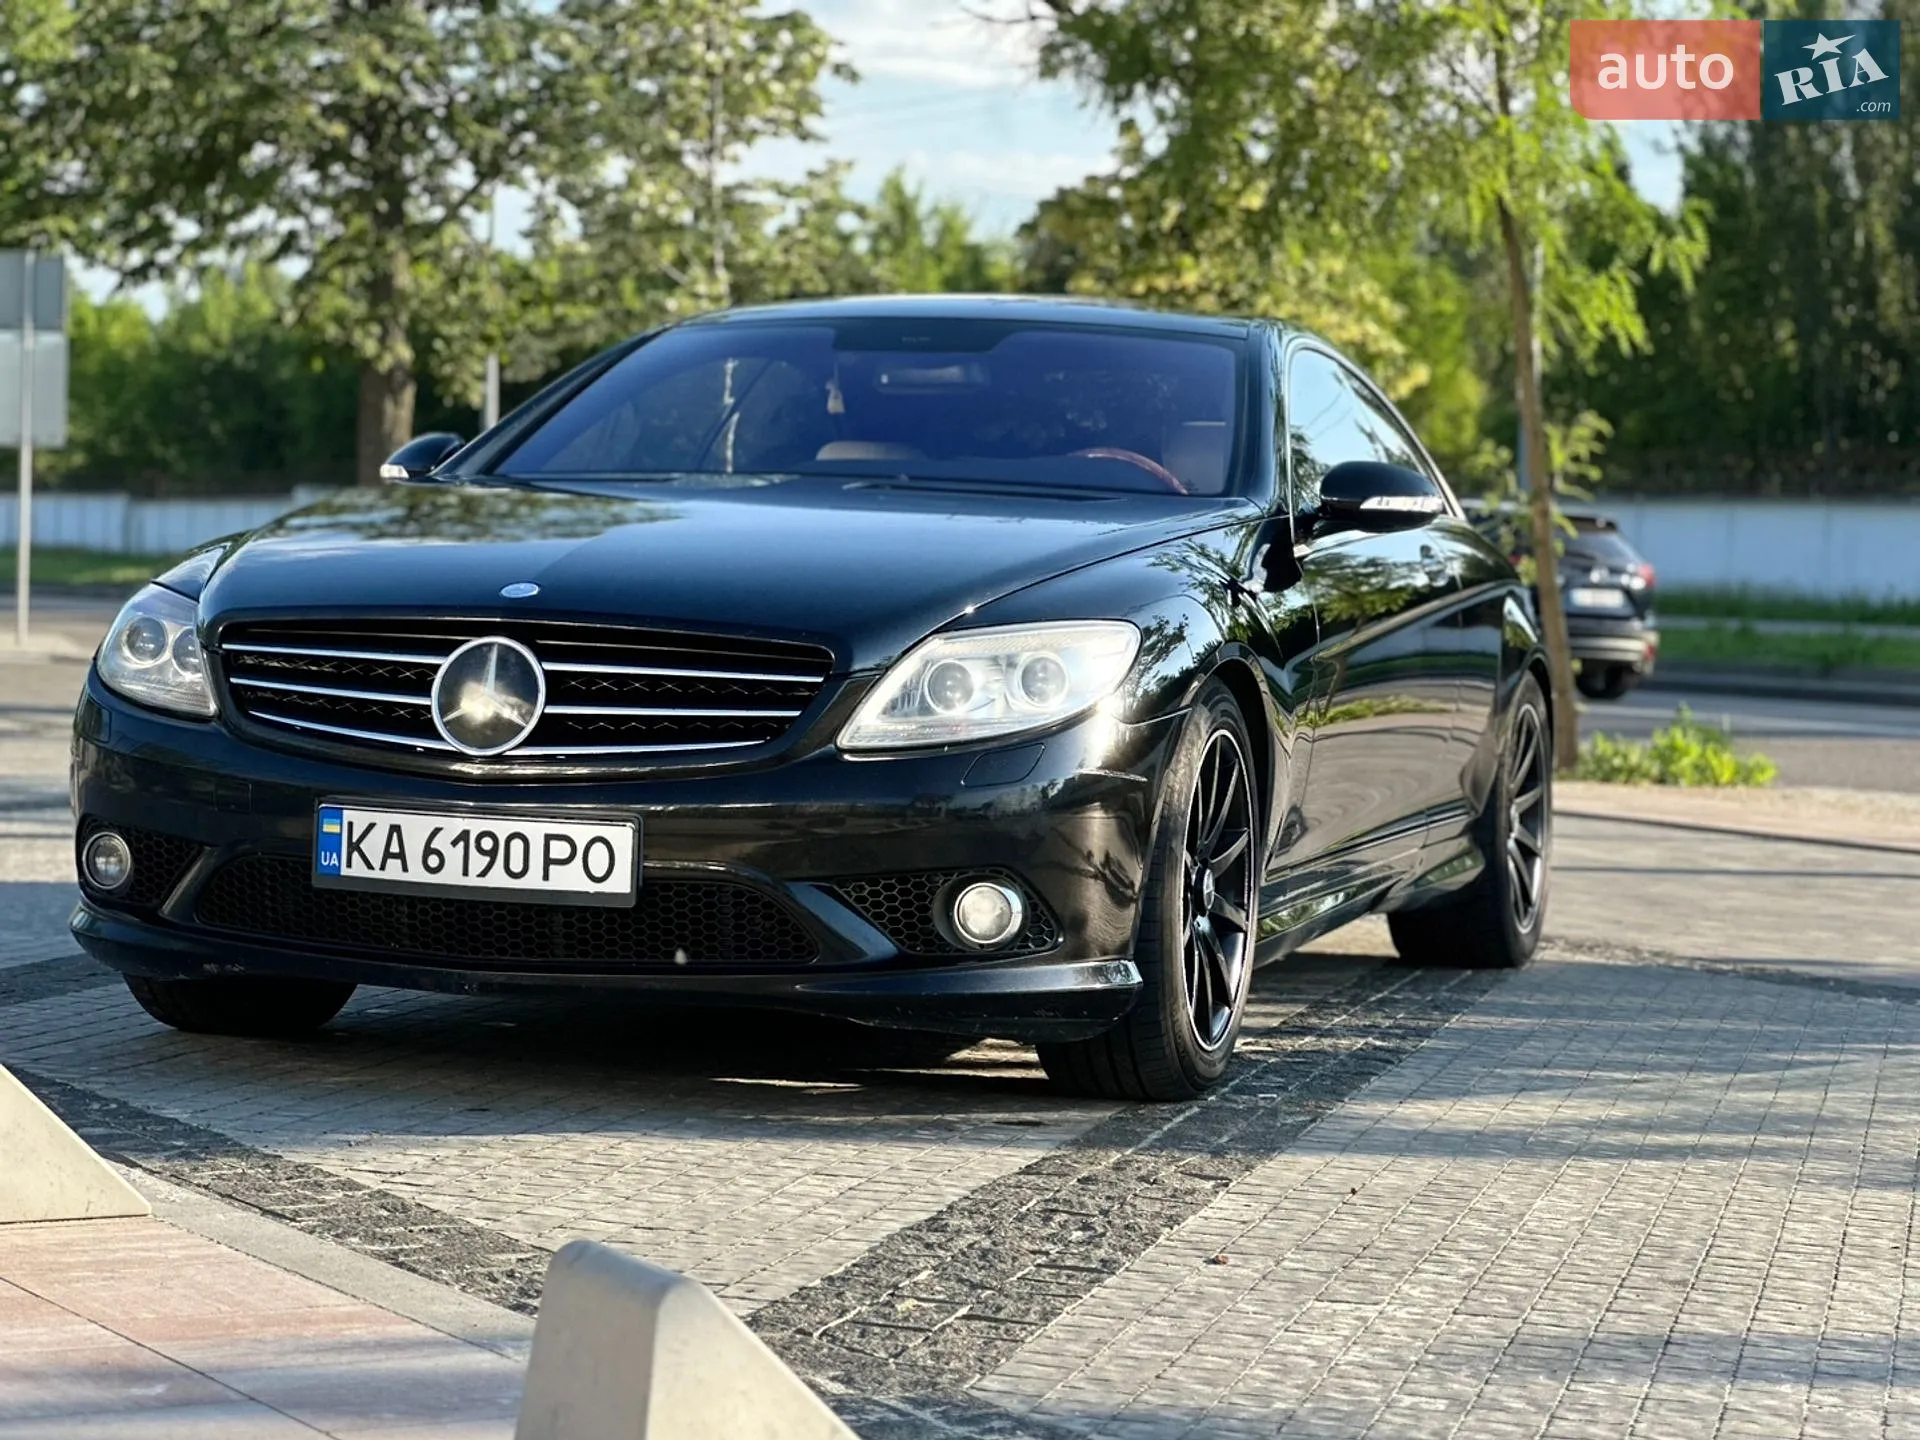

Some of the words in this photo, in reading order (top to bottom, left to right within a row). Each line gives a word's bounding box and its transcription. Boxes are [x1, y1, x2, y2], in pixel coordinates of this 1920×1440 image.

[321, 851, 339, 867] UA
[345, 820, 409, 874] KA
[421, 827, 530, 880] 6190
[542, 832, 616, 884] PO
